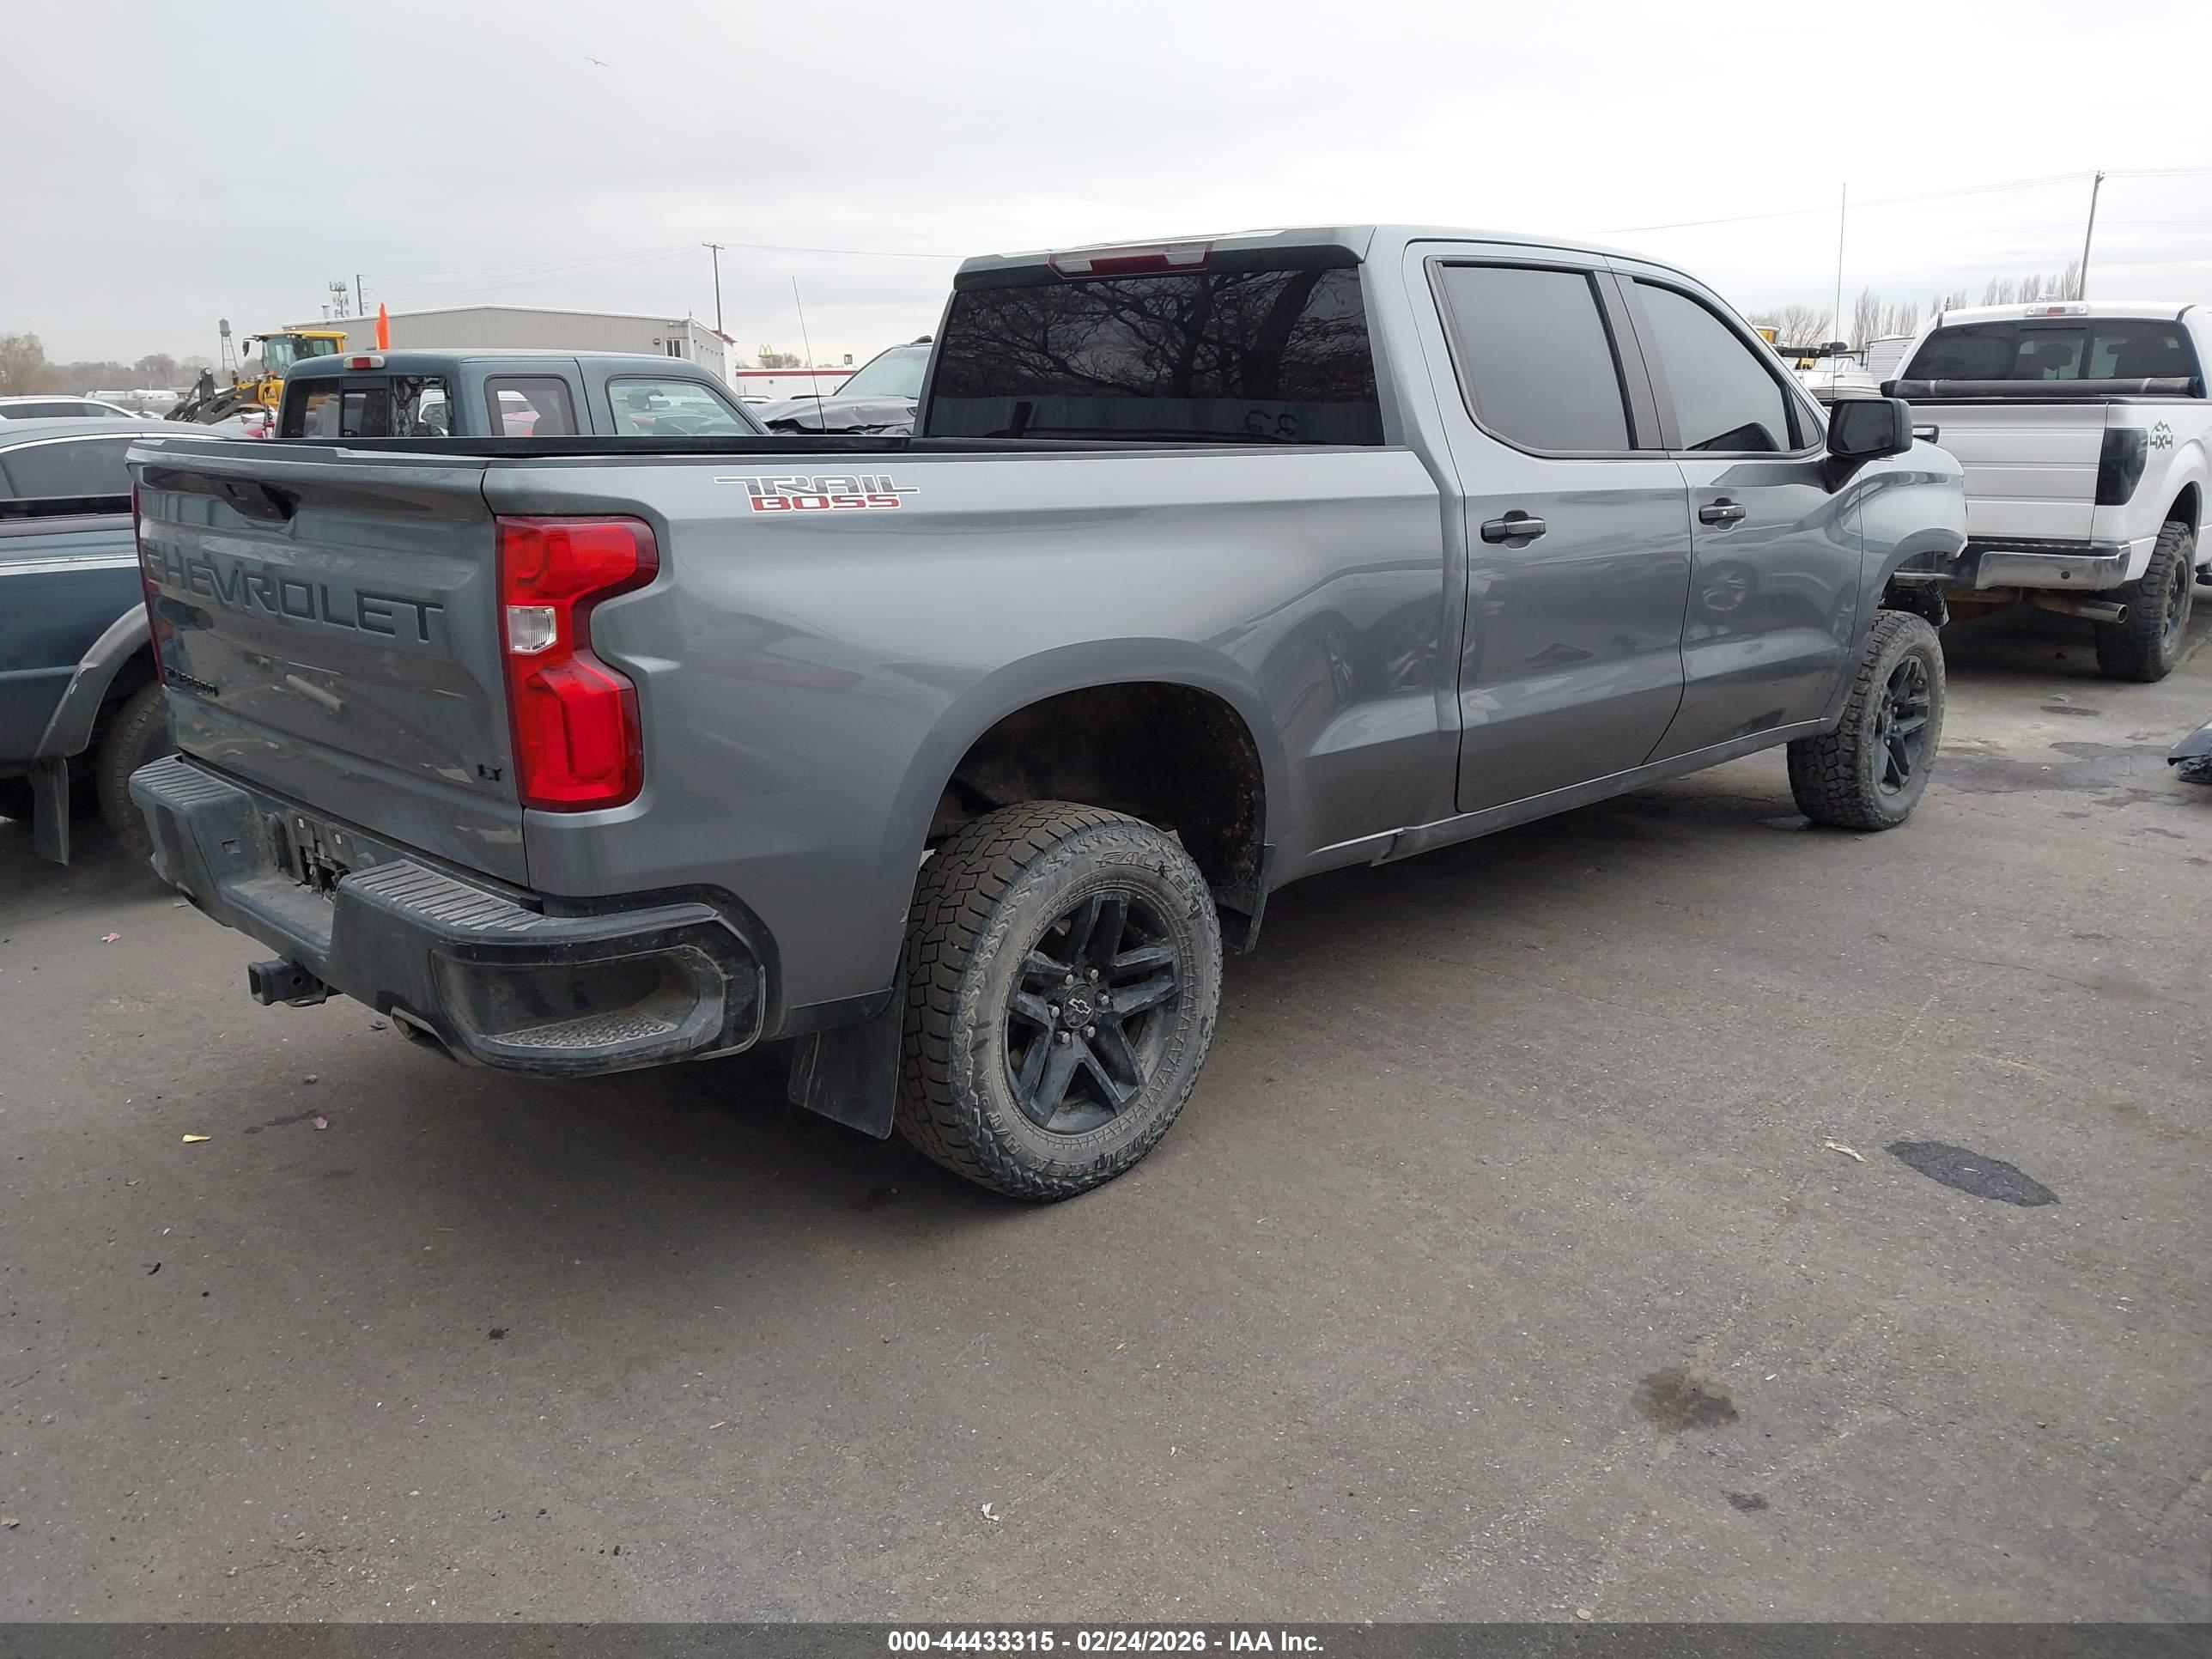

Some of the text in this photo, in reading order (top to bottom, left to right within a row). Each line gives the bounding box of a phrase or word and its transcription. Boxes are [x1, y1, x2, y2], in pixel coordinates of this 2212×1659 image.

[714, 474, 921, 495] TRAIL
[750, 494, 902, 513] BOSS
[142, 538, 445, 644] CHEVROLET
[477, 763, 502, 782] LT
[1096, 851, 1202, 920] FALKEN
